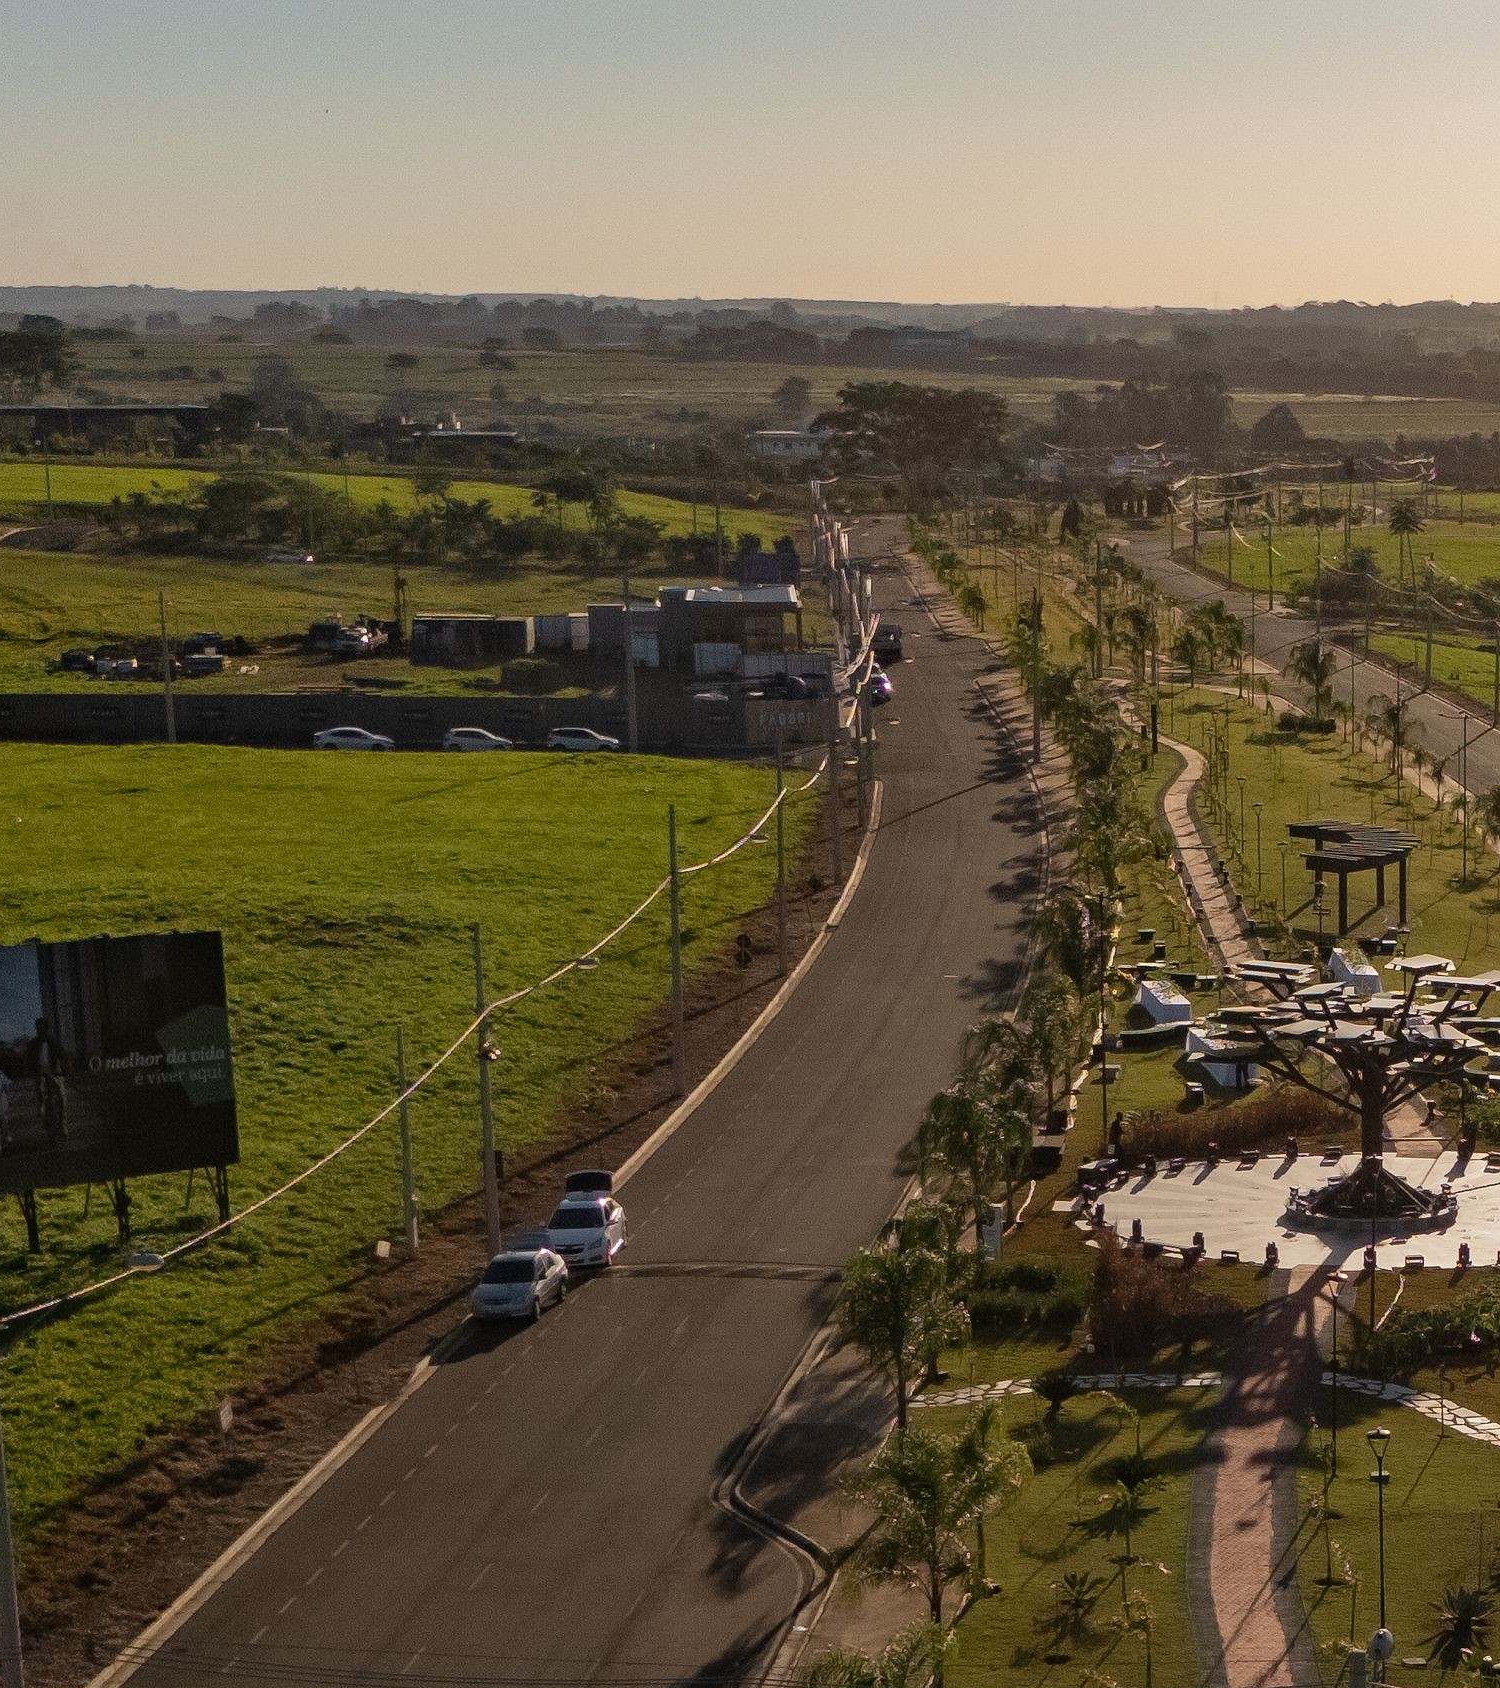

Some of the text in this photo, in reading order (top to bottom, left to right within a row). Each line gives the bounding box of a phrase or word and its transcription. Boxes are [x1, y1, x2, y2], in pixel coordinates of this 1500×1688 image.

[105, 1050, 163, 1071] melhor
[166, 1048, 187, 1065] da
[190, 1045, 226, 1063] vida
[146, 1068, 185, 1085] viver
